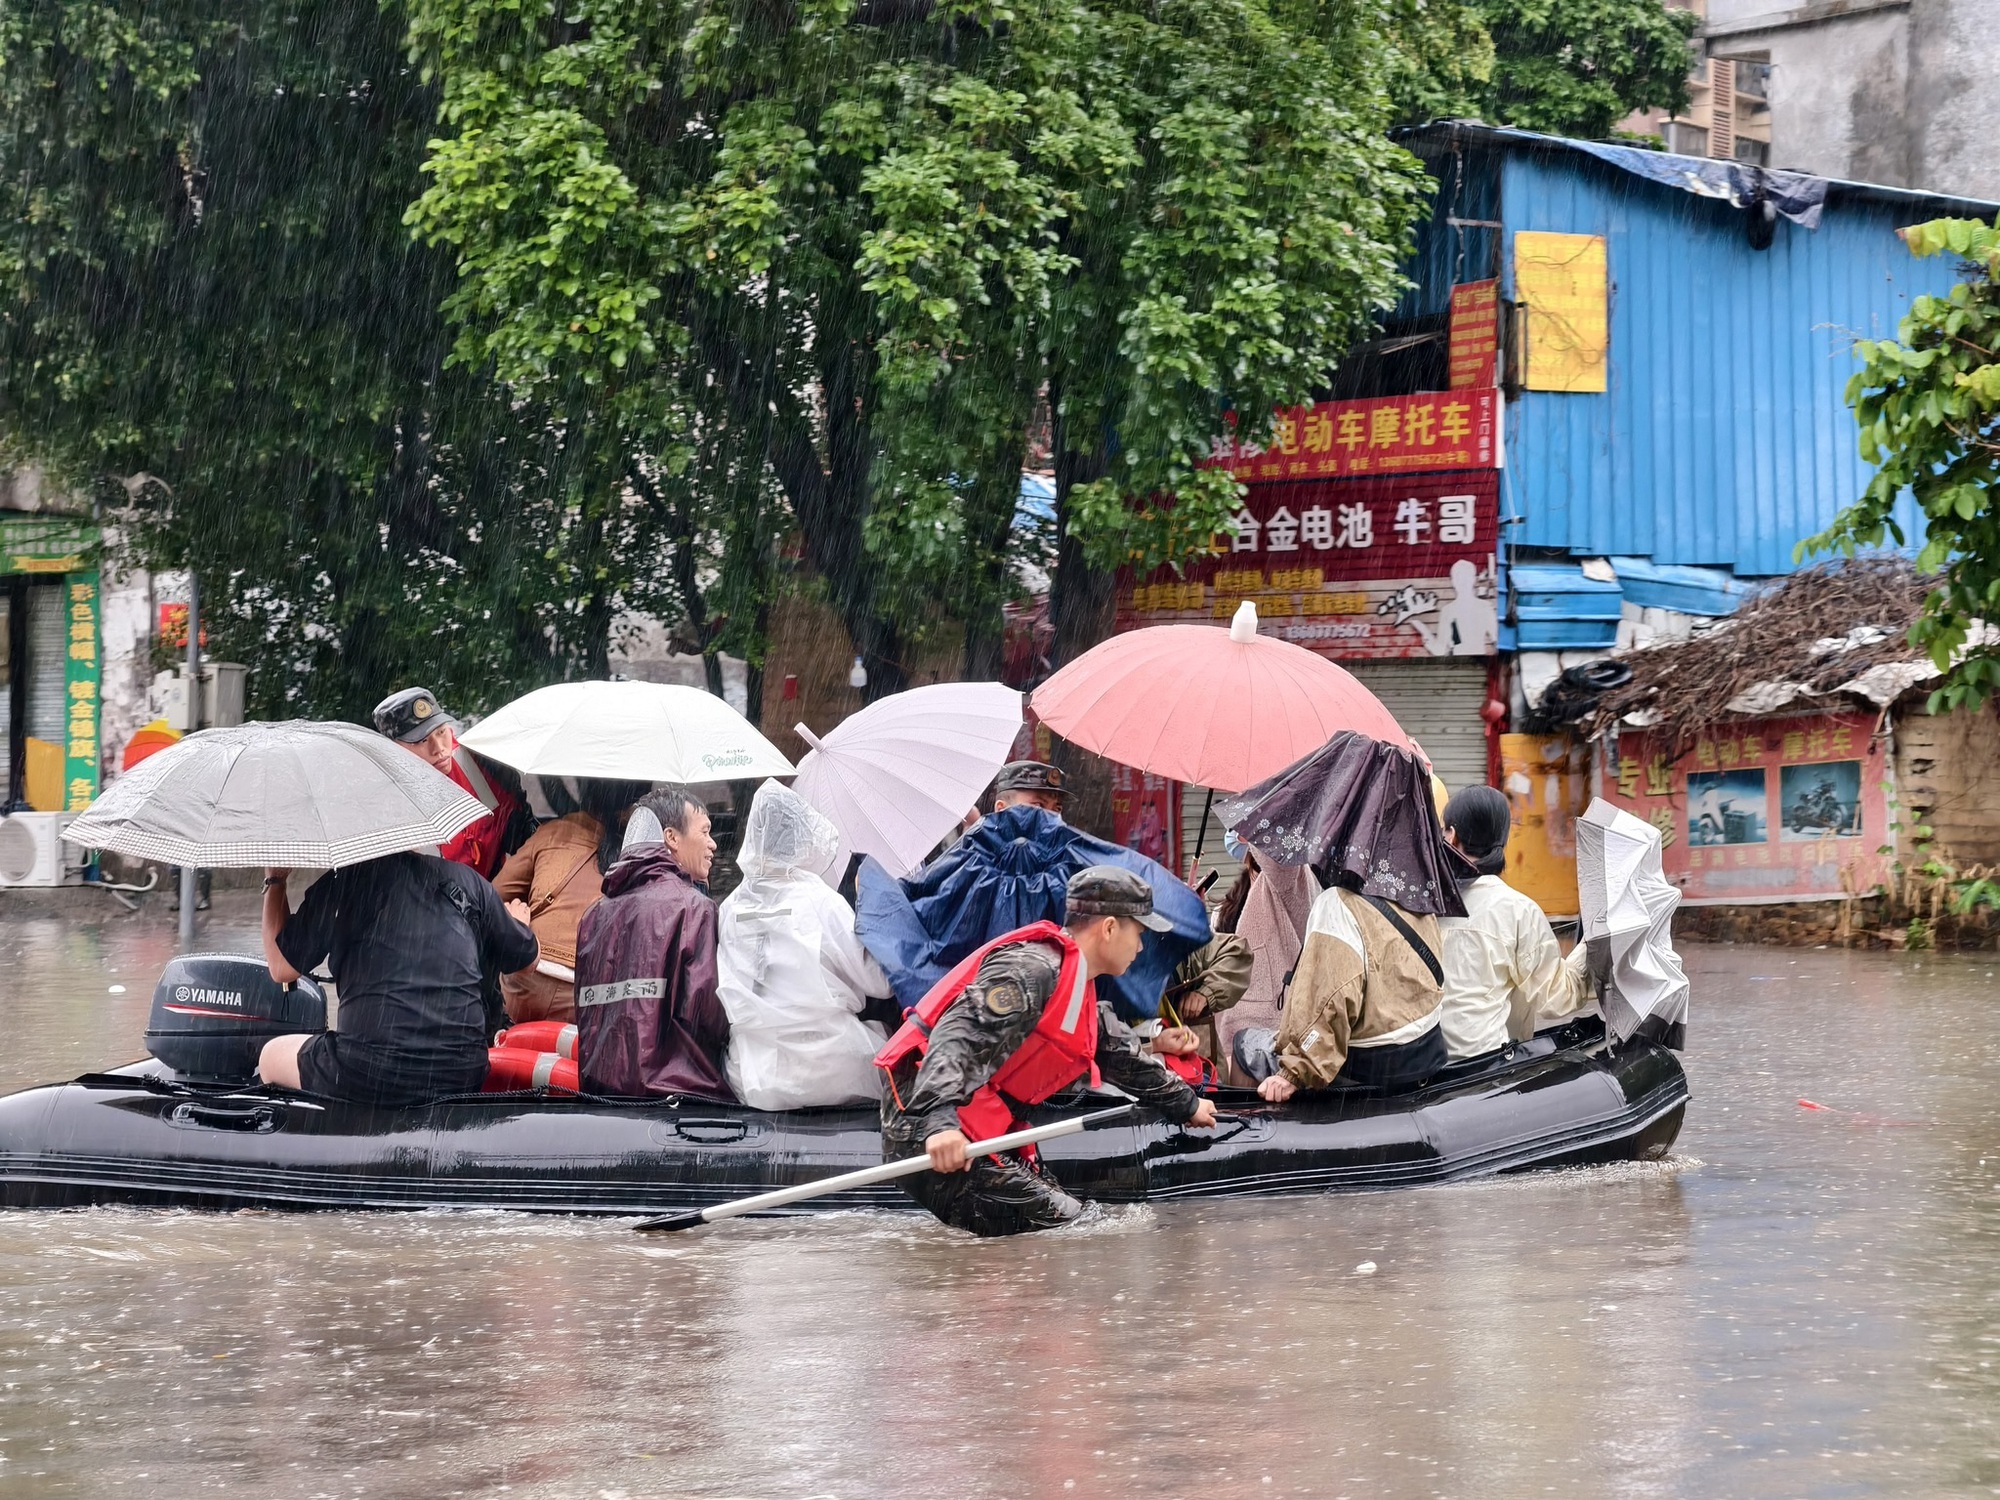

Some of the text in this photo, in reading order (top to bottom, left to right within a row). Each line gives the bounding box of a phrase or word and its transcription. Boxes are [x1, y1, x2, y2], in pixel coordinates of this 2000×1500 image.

[1272, 401, 1472, 455] 电动车摩托车
[1231, 501, 1374, 552] 合金电池
[1394, 494, 1477, 546] 牛哥
[1616, 754, 1675, 799] 专业
[191, 988, 242, 1006] YAMAHA
